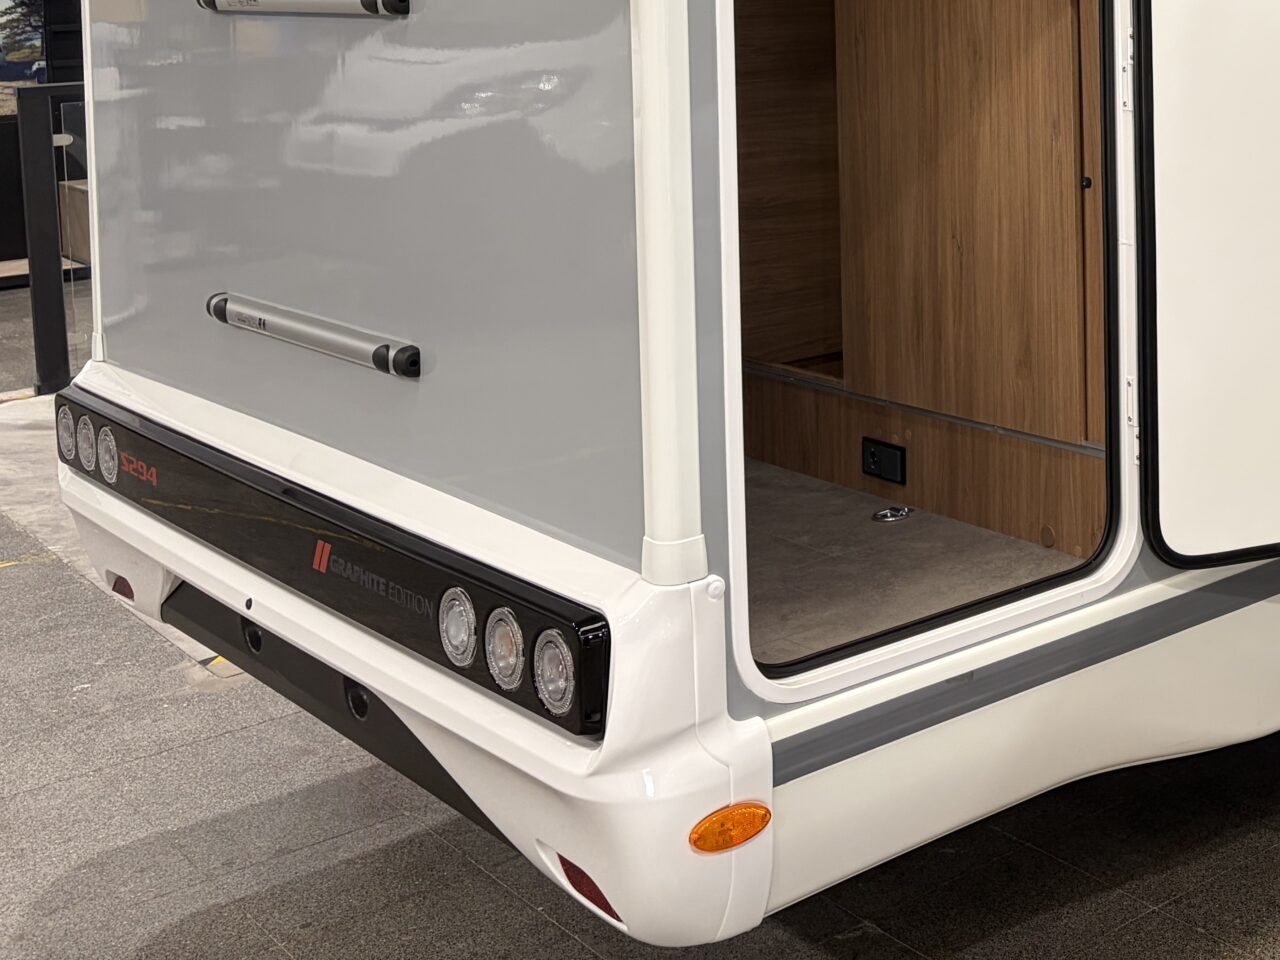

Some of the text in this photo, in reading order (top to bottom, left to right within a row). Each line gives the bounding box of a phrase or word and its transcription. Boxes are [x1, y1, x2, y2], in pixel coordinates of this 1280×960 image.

[120, 449, 434, 619] S294 GRAPHITE EDITION
